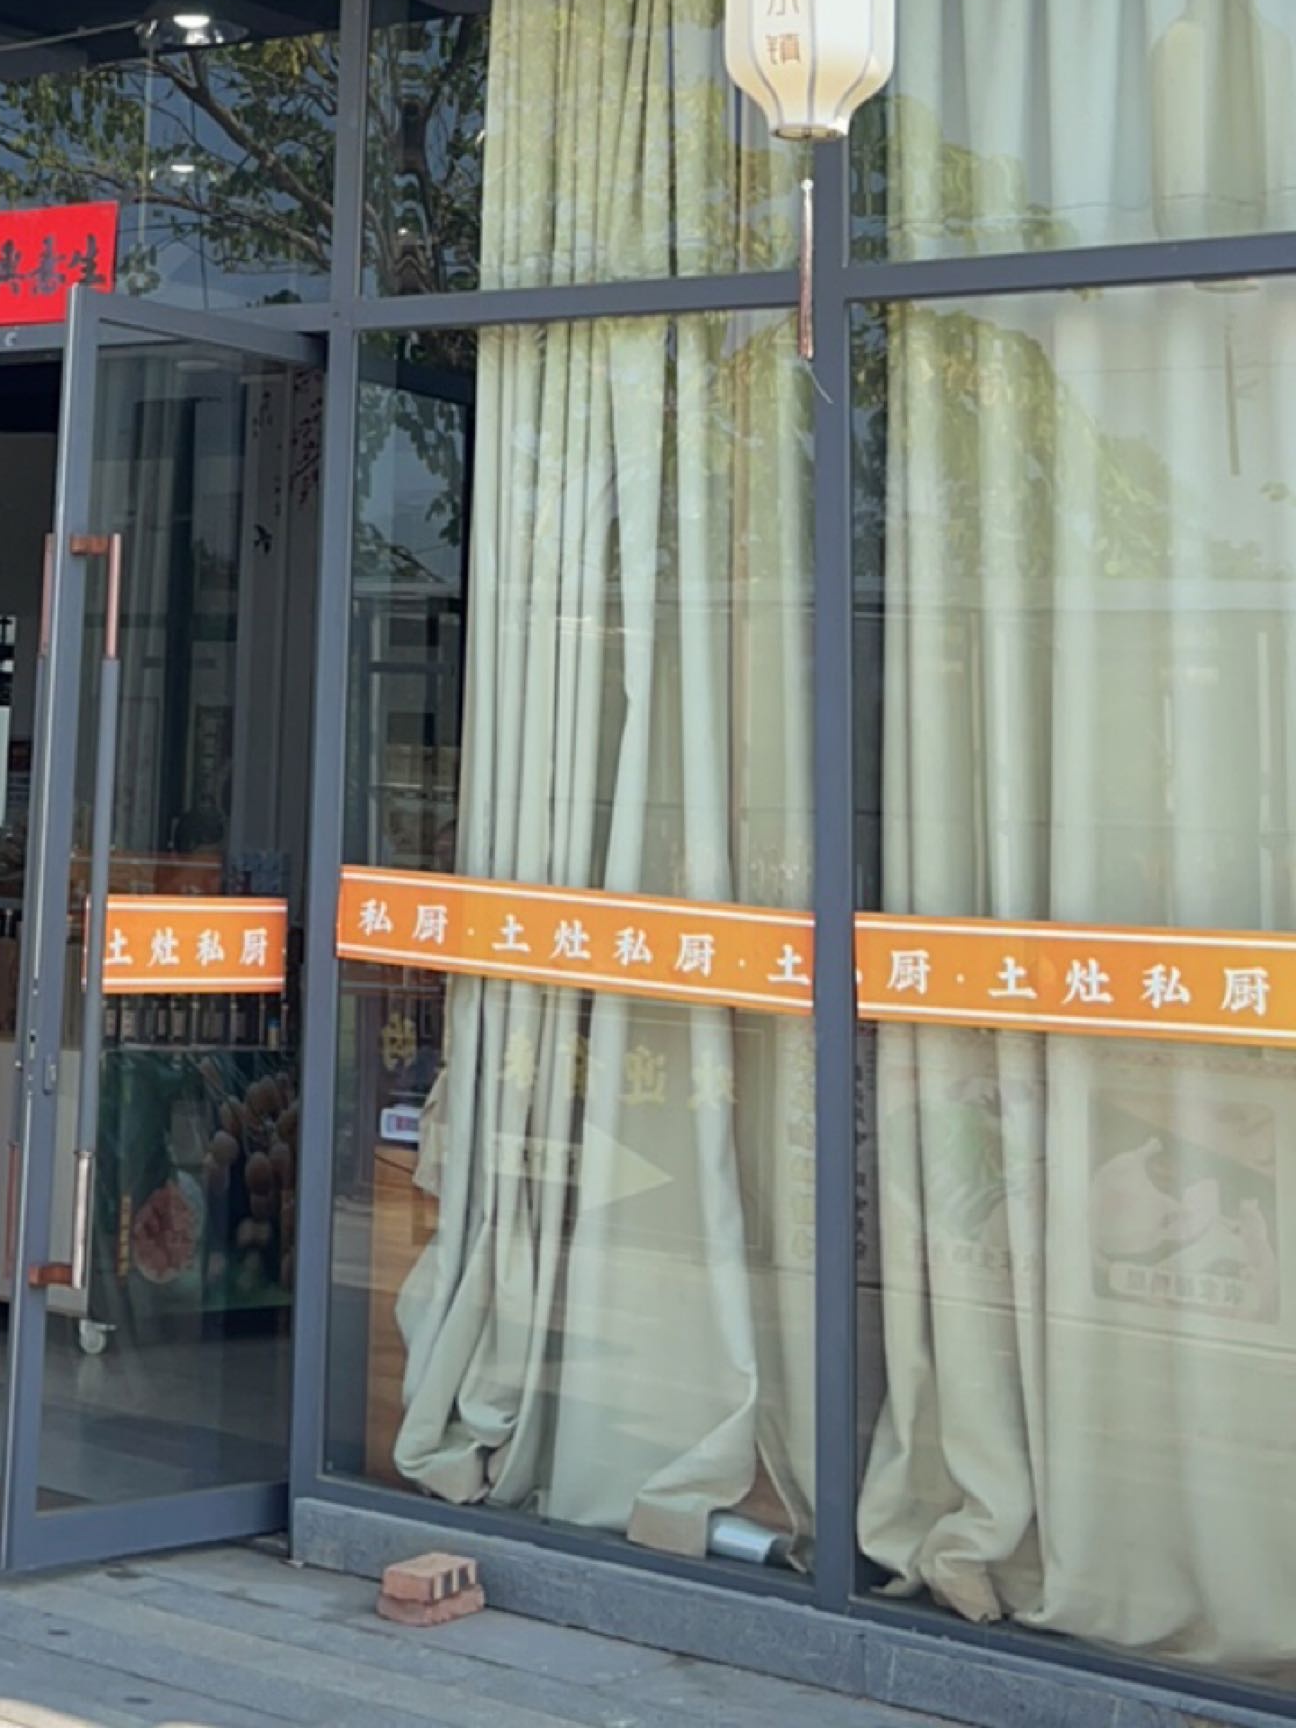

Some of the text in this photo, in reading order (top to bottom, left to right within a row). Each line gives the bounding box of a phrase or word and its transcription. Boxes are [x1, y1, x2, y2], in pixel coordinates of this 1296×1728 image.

[102, 925, 269, 968] 土灶私厨
[856, 947, 1272, 1017] 厨·土灶私厨
